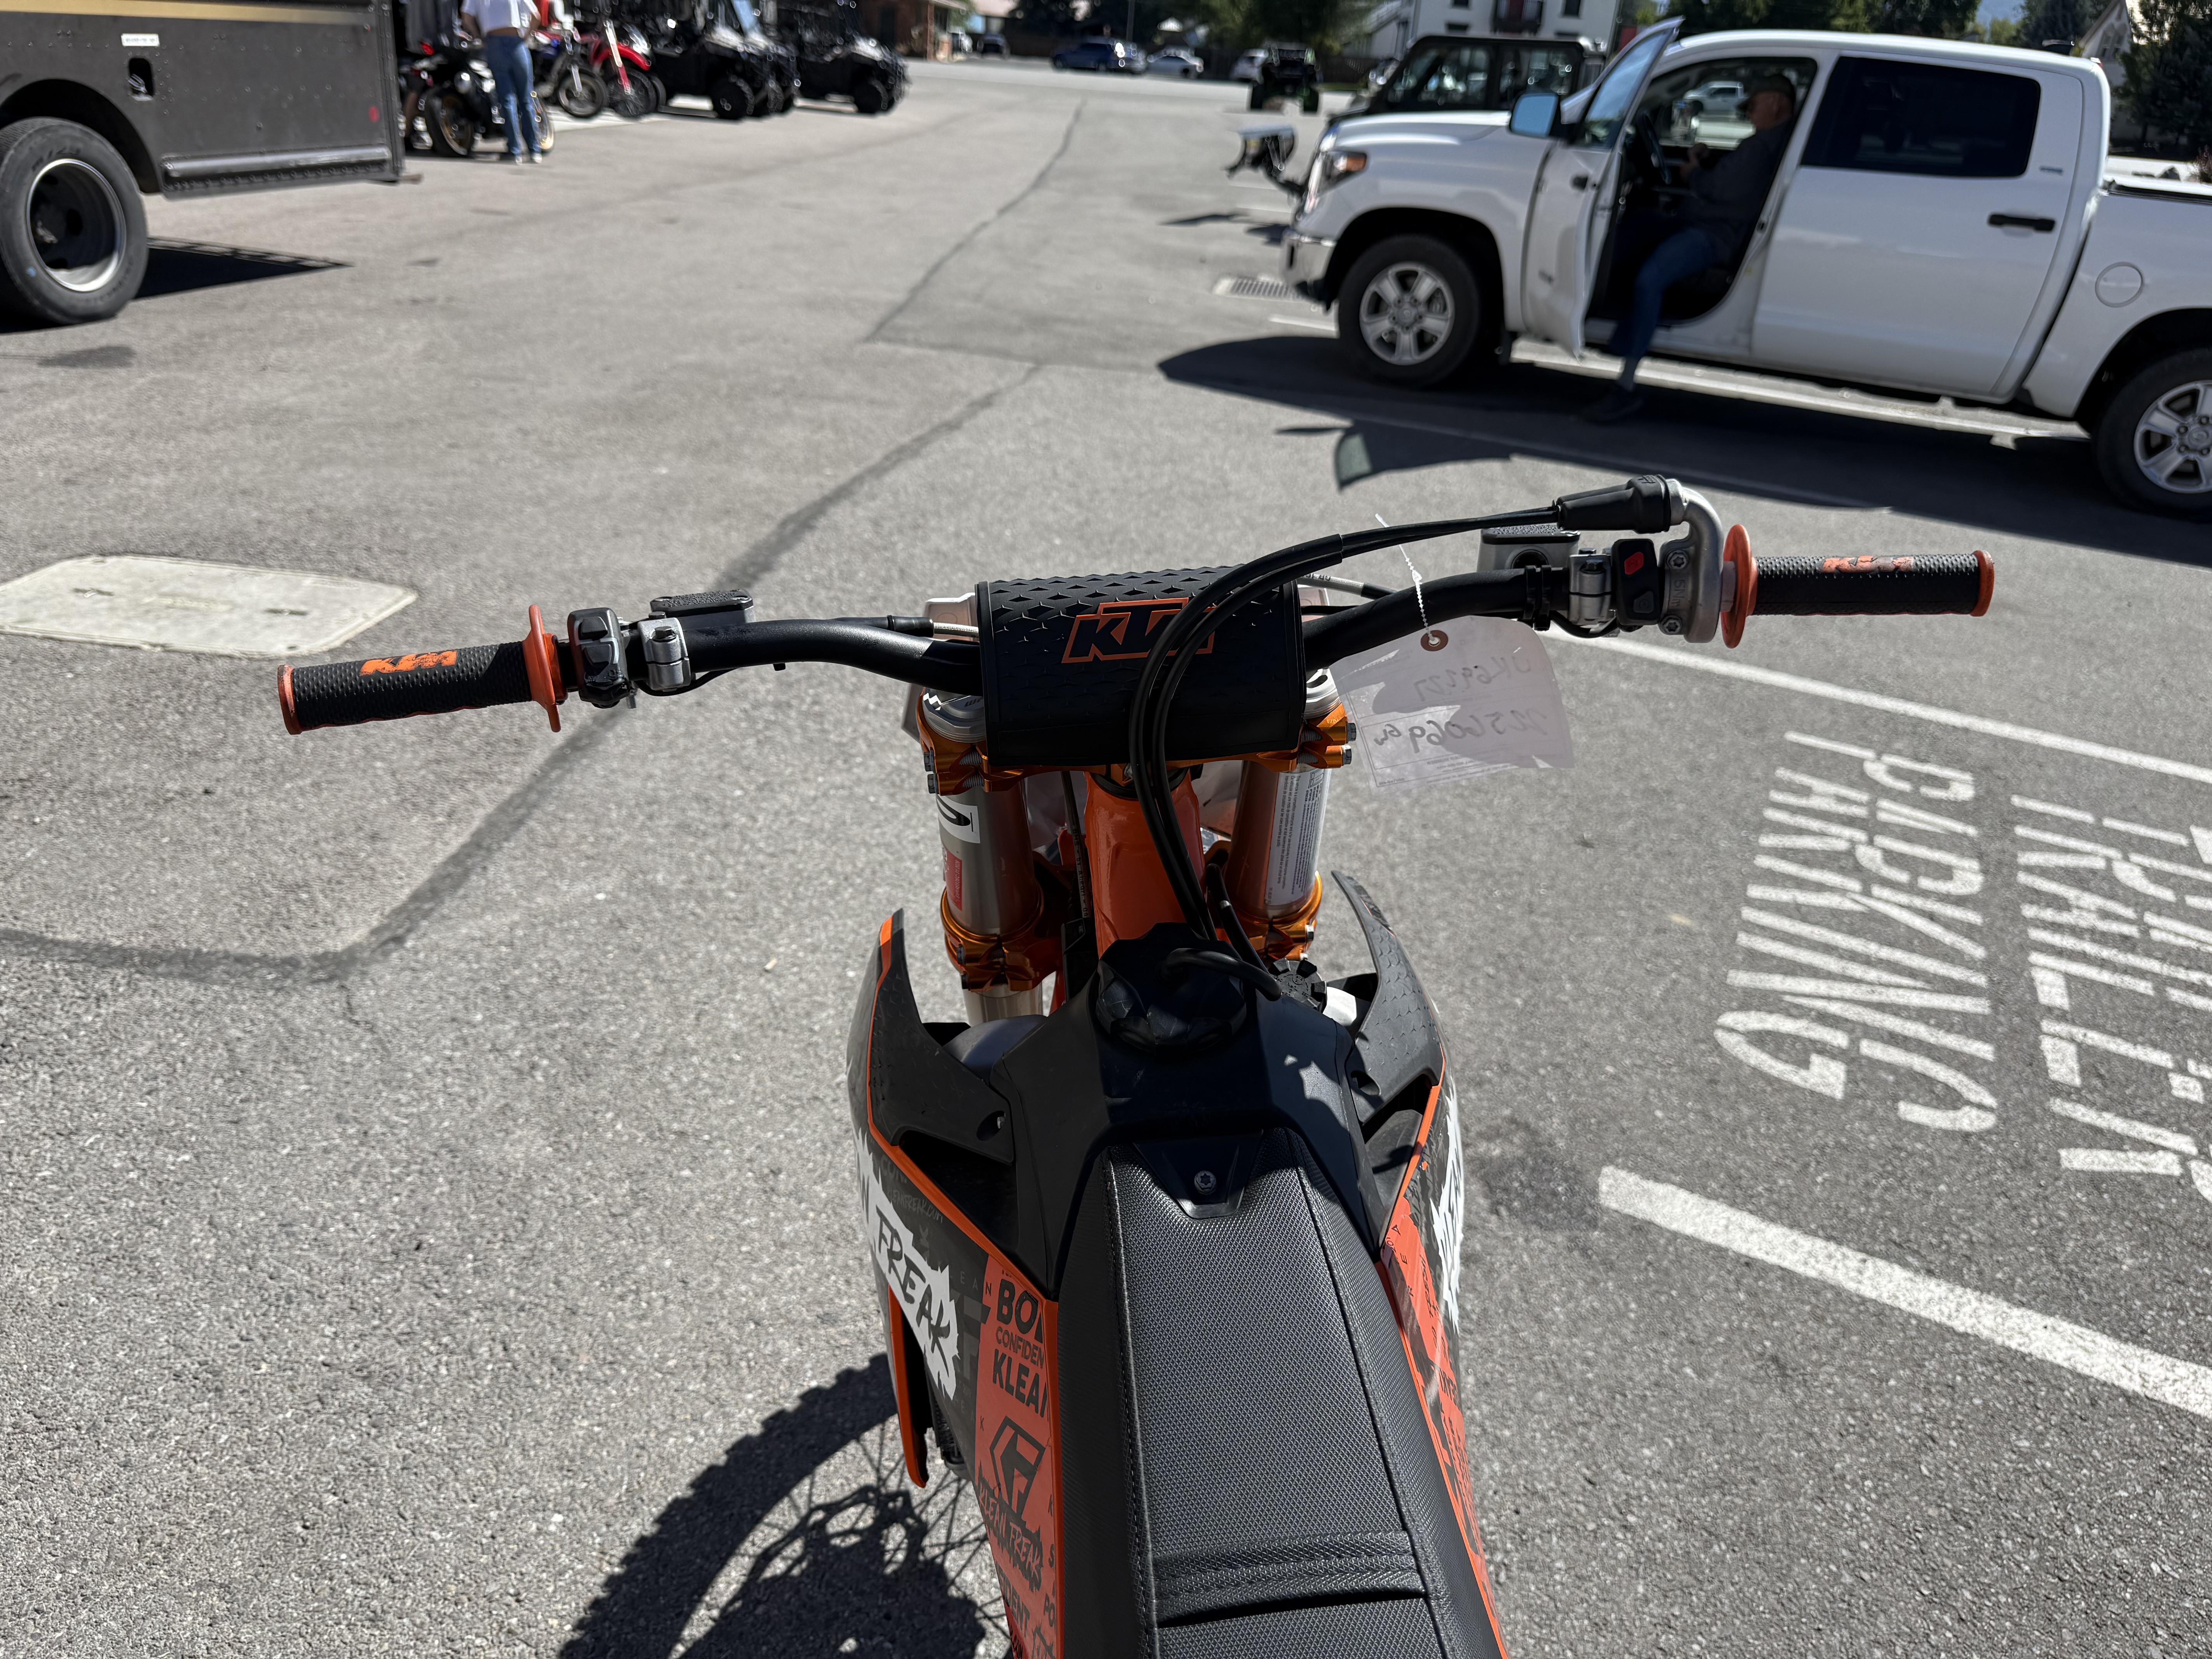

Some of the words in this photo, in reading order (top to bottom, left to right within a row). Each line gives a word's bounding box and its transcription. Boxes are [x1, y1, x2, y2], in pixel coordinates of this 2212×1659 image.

[1713, 731, 1997, 1132] PARKING
[876, 1204, 951, 1377] FREAK
[1010, 1522, 1041, 1582] FREAK
